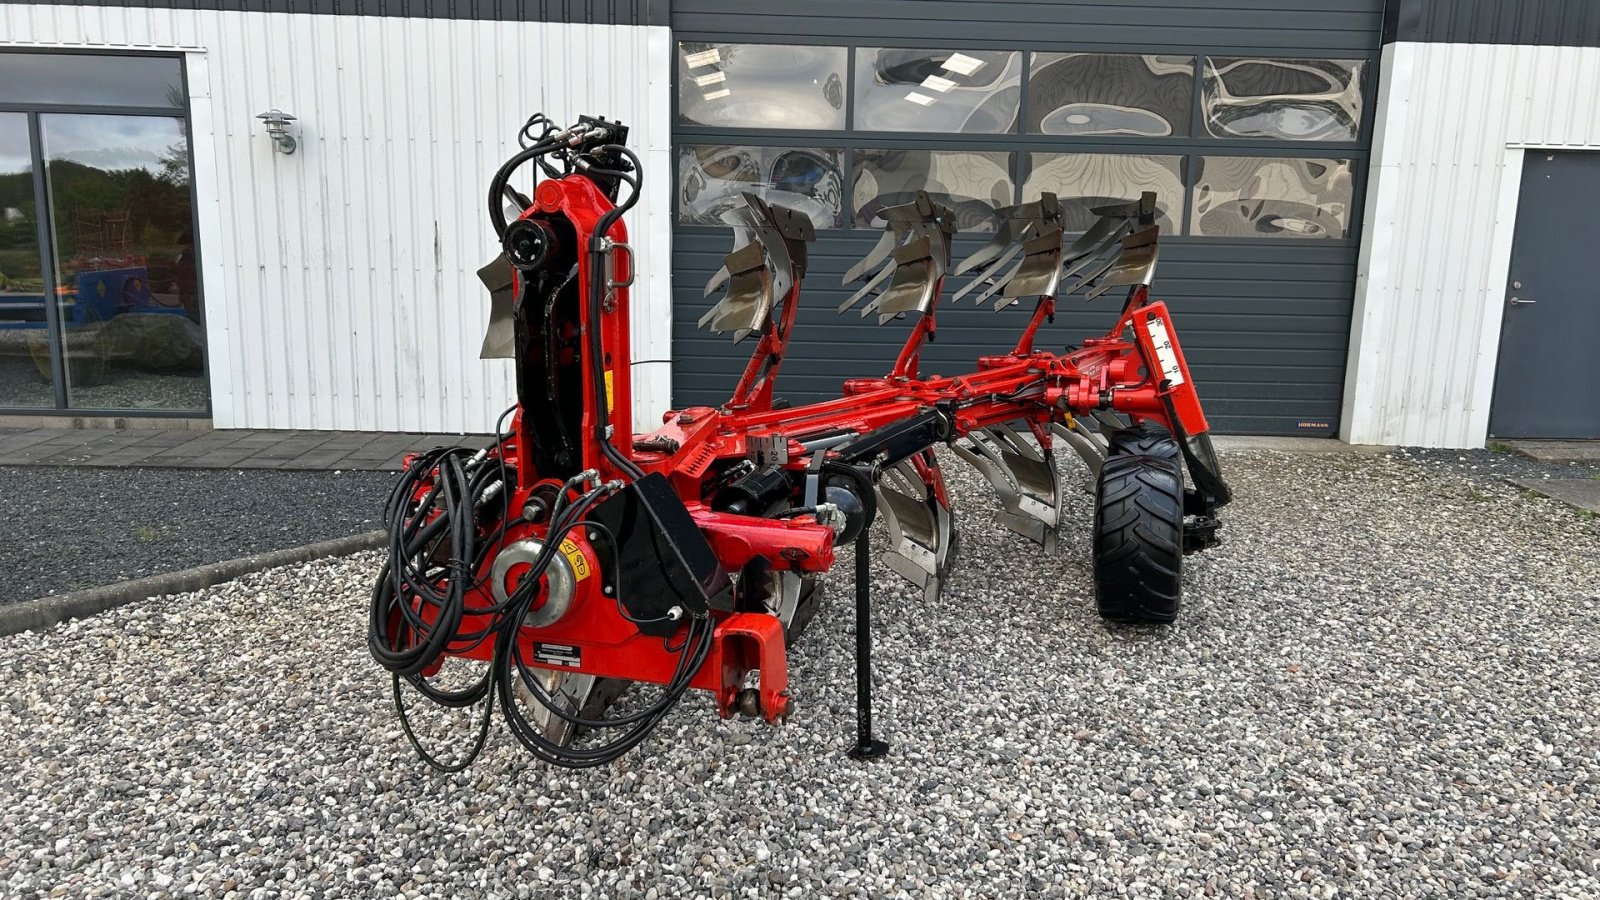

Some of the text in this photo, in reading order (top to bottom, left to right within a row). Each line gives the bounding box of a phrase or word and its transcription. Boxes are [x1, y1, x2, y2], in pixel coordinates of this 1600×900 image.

[1163, 340, 1171, 350] 20
[1172, 365, 1179, 373] 10
[770, 451, 778, 461] 20
